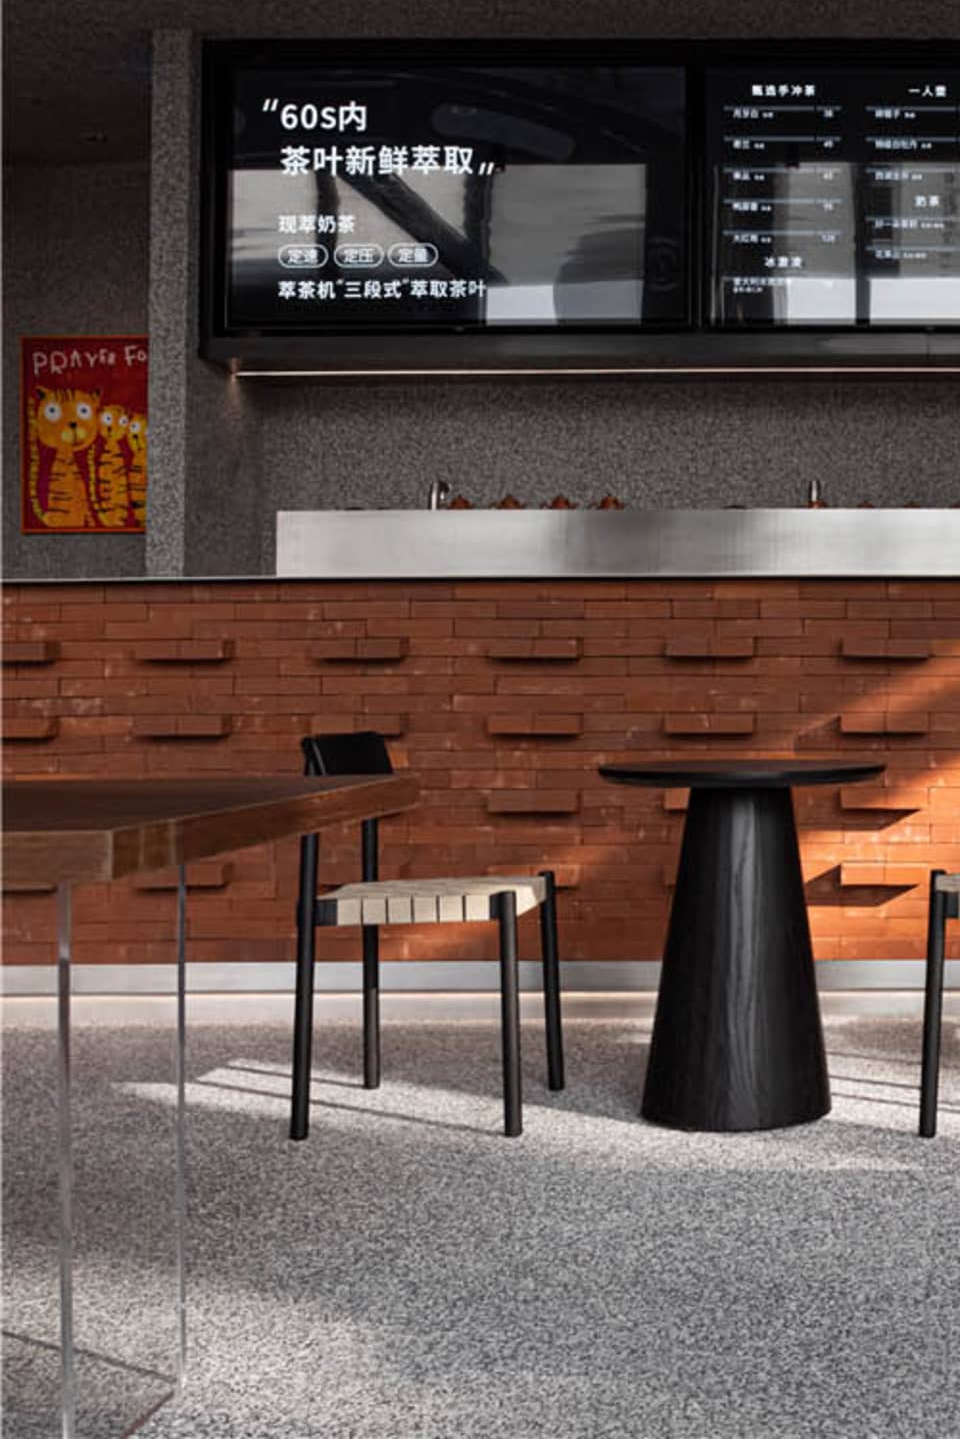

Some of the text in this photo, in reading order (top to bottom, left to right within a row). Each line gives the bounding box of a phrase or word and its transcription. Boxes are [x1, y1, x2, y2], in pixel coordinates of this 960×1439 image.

[278, 215, 355, 234] 现萃奶茶
[343, 248, 374, 263] 定压
[397, 247, 428, 263] 定量
